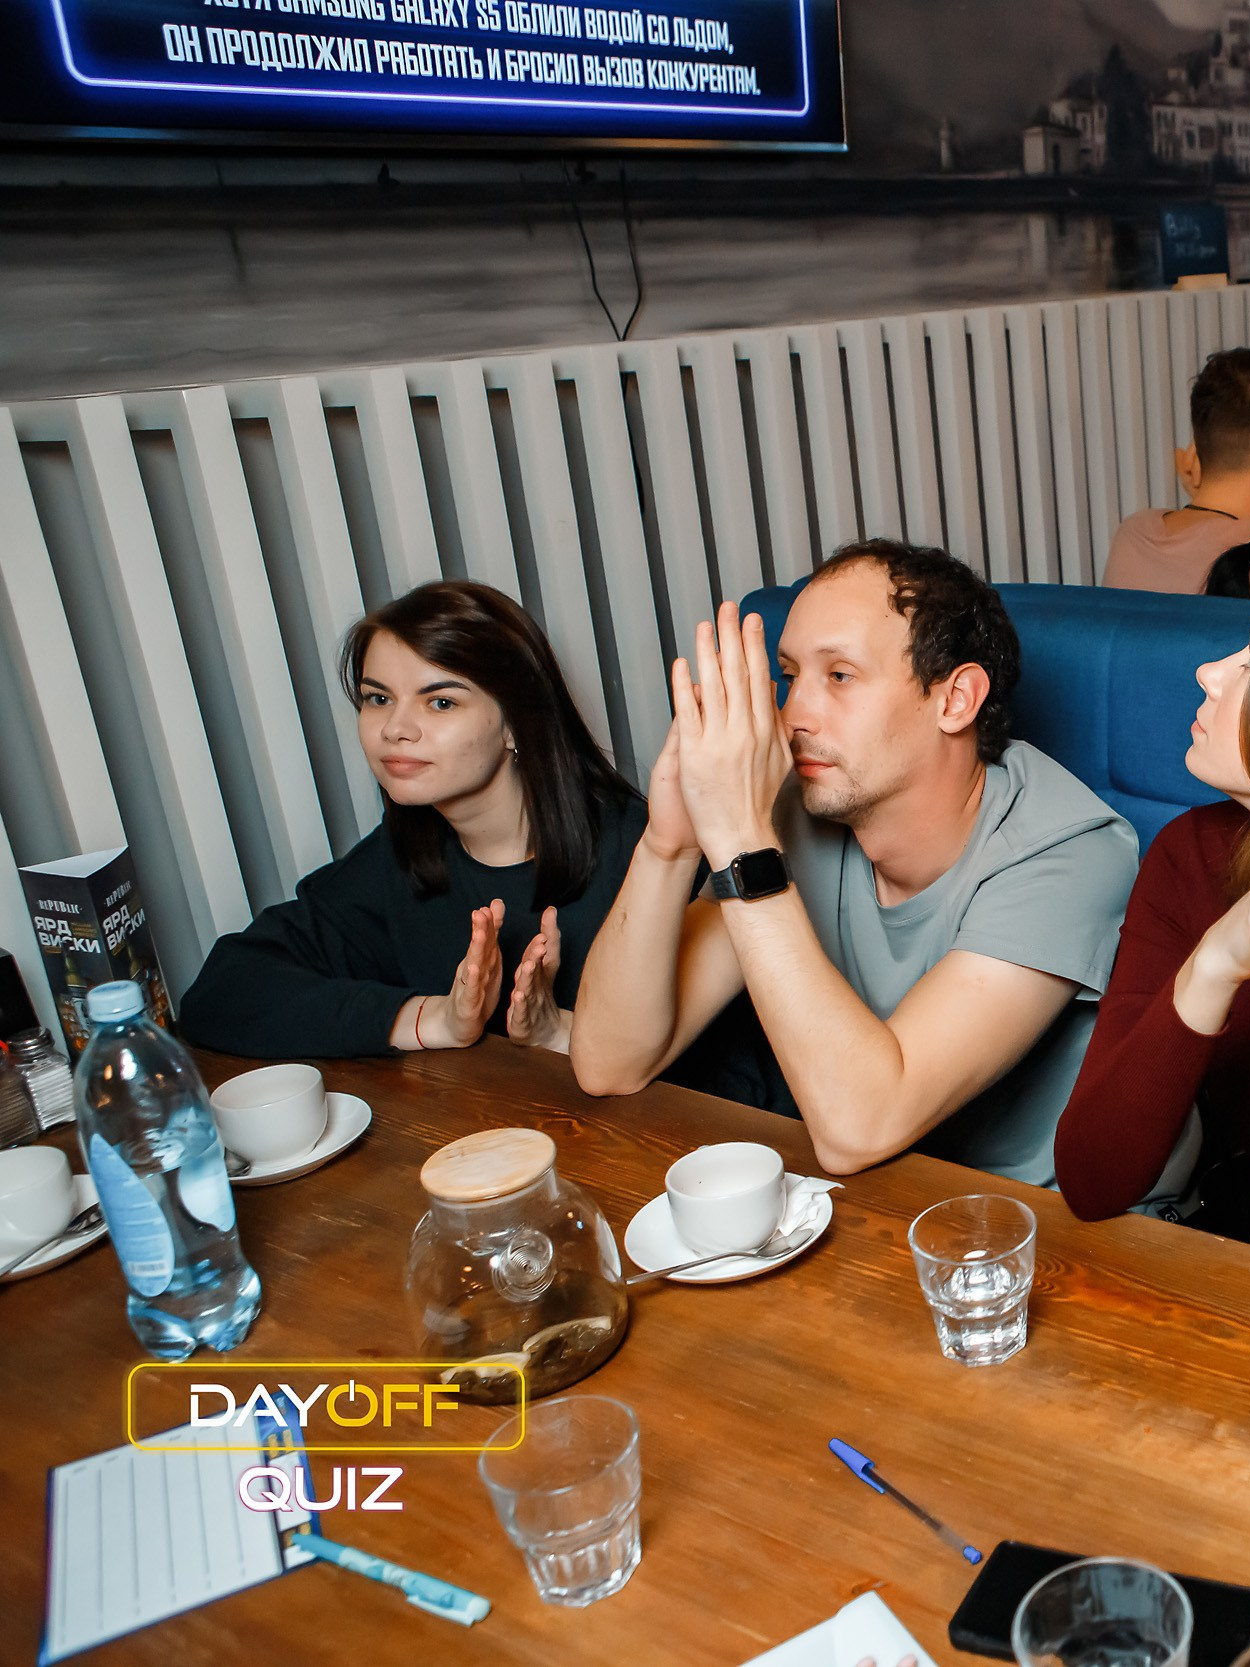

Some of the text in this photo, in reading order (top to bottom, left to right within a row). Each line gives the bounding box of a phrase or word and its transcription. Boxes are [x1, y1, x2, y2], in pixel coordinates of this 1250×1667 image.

[391, 0, 469, 28] GALAXY
[475, 0, 502, 31] S5
[504, 1, 582, 38] ОБЛИЛИ
[584, 8, 645, 46] ВОДОЙ
[646, 14, 670, 46] СО
[672, 16, 735, 55] ЛЬДОМ,
[162, 23, 762, 96] ОН ПРОДОЛЖИЛ РАБОТАТЬ И БРОСИЛ ВЫЗОВ КОНКУРЕНТАМ.
[34, 916, 72, 937] ЯРД
[102, 904, 131, 935] ЯРД
